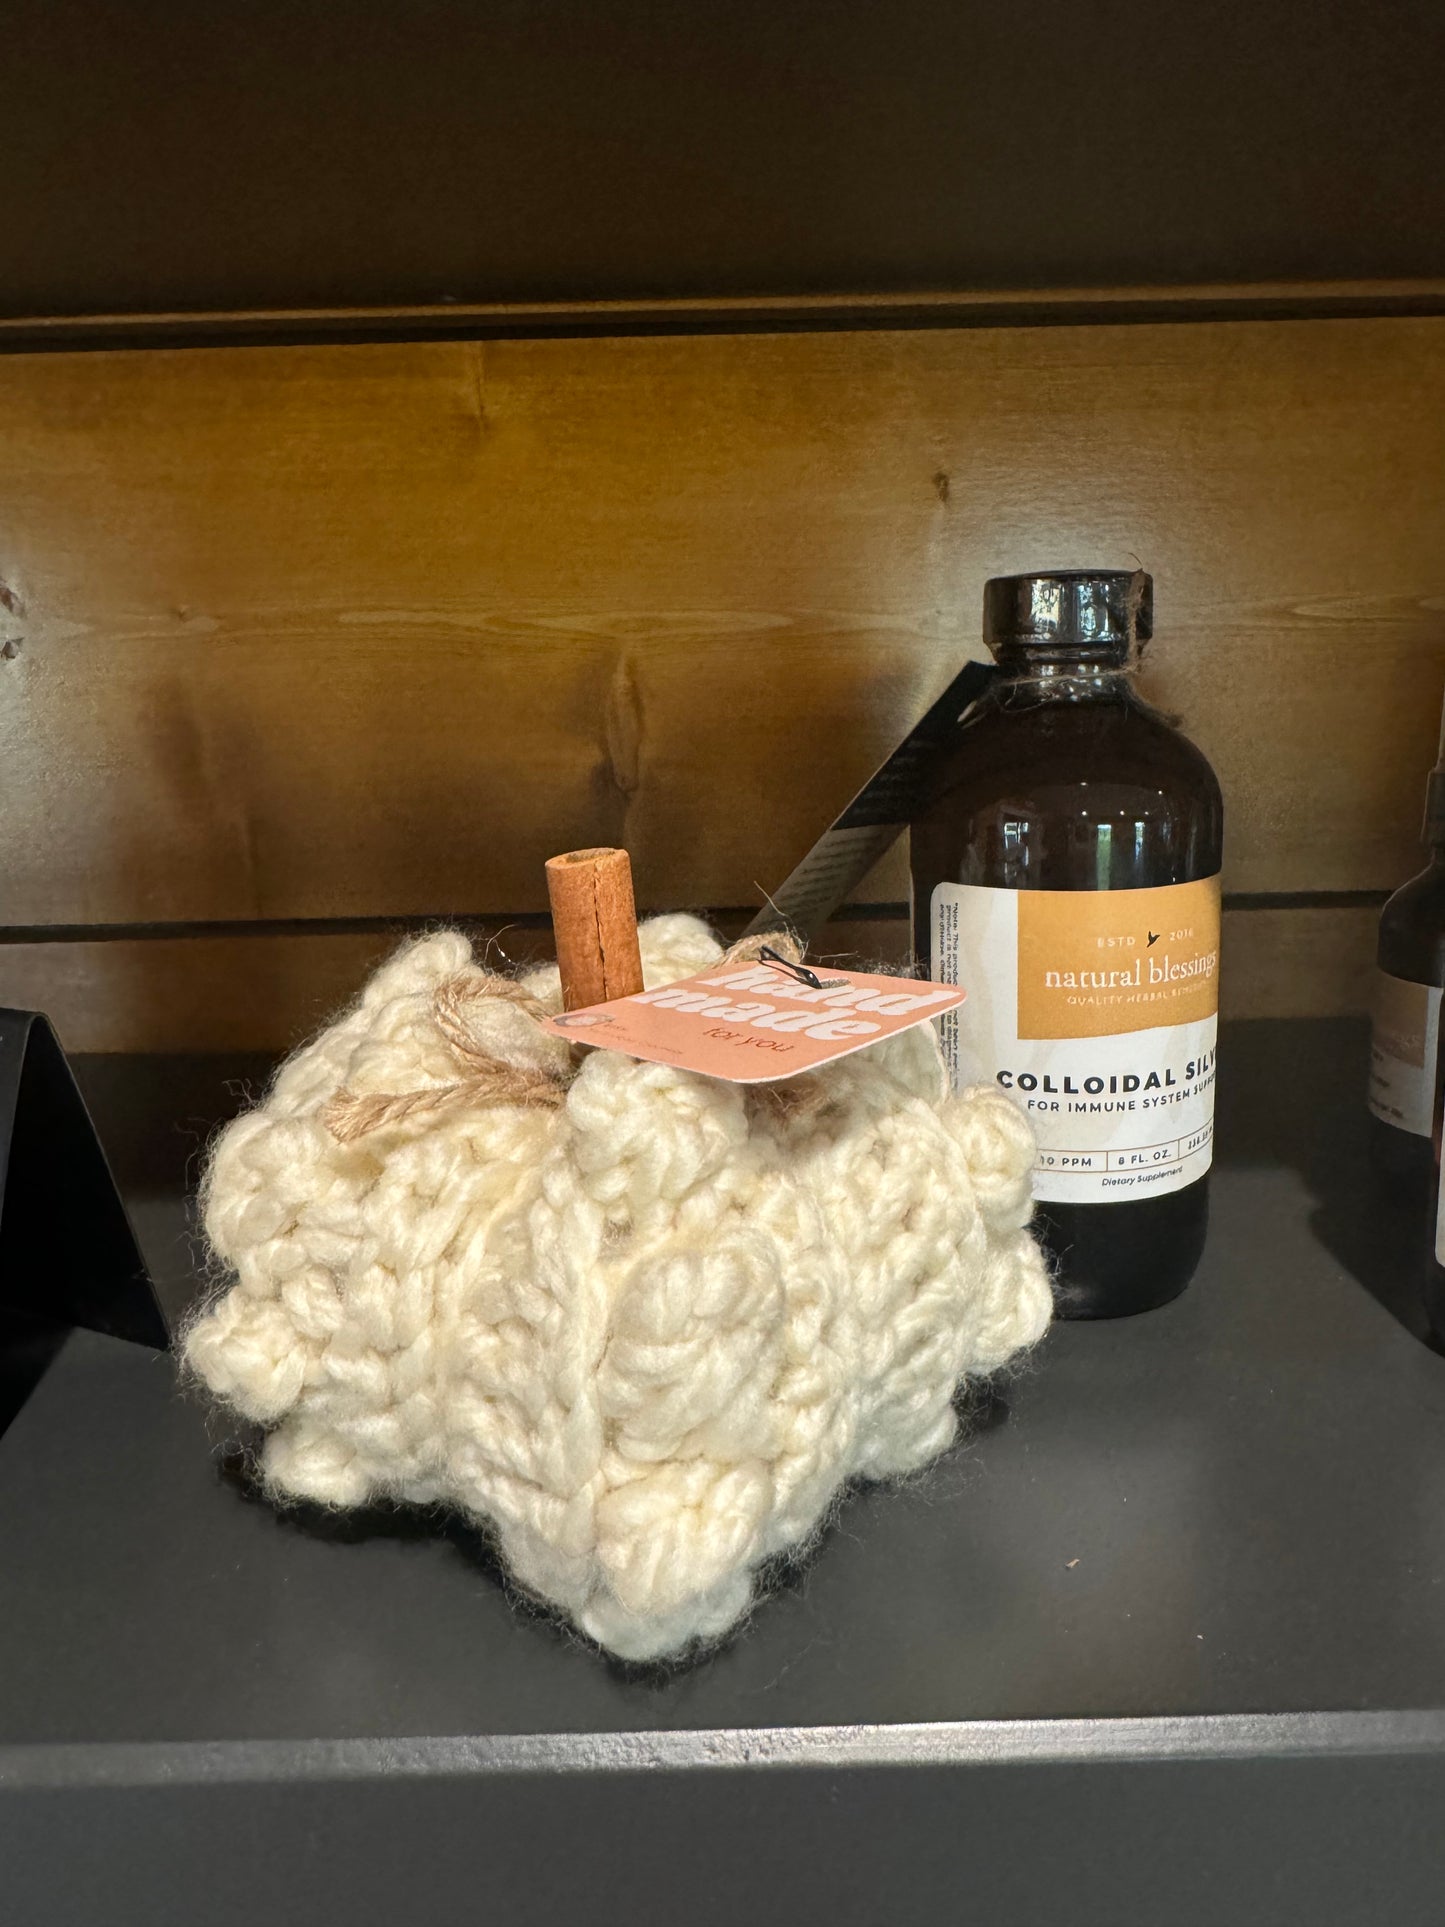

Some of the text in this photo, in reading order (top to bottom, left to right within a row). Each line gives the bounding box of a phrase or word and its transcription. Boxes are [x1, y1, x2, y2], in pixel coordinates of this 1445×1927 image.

[1096, 936, 1136, 949] ESTD
[1045, 950, 1217, 989] natural blessings
[695, 964, 961, 1017] hand
[1067, 995, 1124, 1007] QUALITY
[631, 988, 882, 1041] made
[702, 1027, 794, 1052] for you
[996, 1068, 1177, 1095] COLLOIDAL
[1185, 1046, 1215, 1081] SILV
[1028, 1099, 1060, 1112] FOR
[1068, 1100, 1136, 1113] IMMUNE
[1142, 1088, 1190, 1109] SYSTEM
[1062, 1157, 1092, 1167] PPM
[1118, 1156, 1125, 1166] 8
[1131, 1153, 1149, 1165] FL.
[1101, 1165, 1184, 1187] Dietary Supplement
